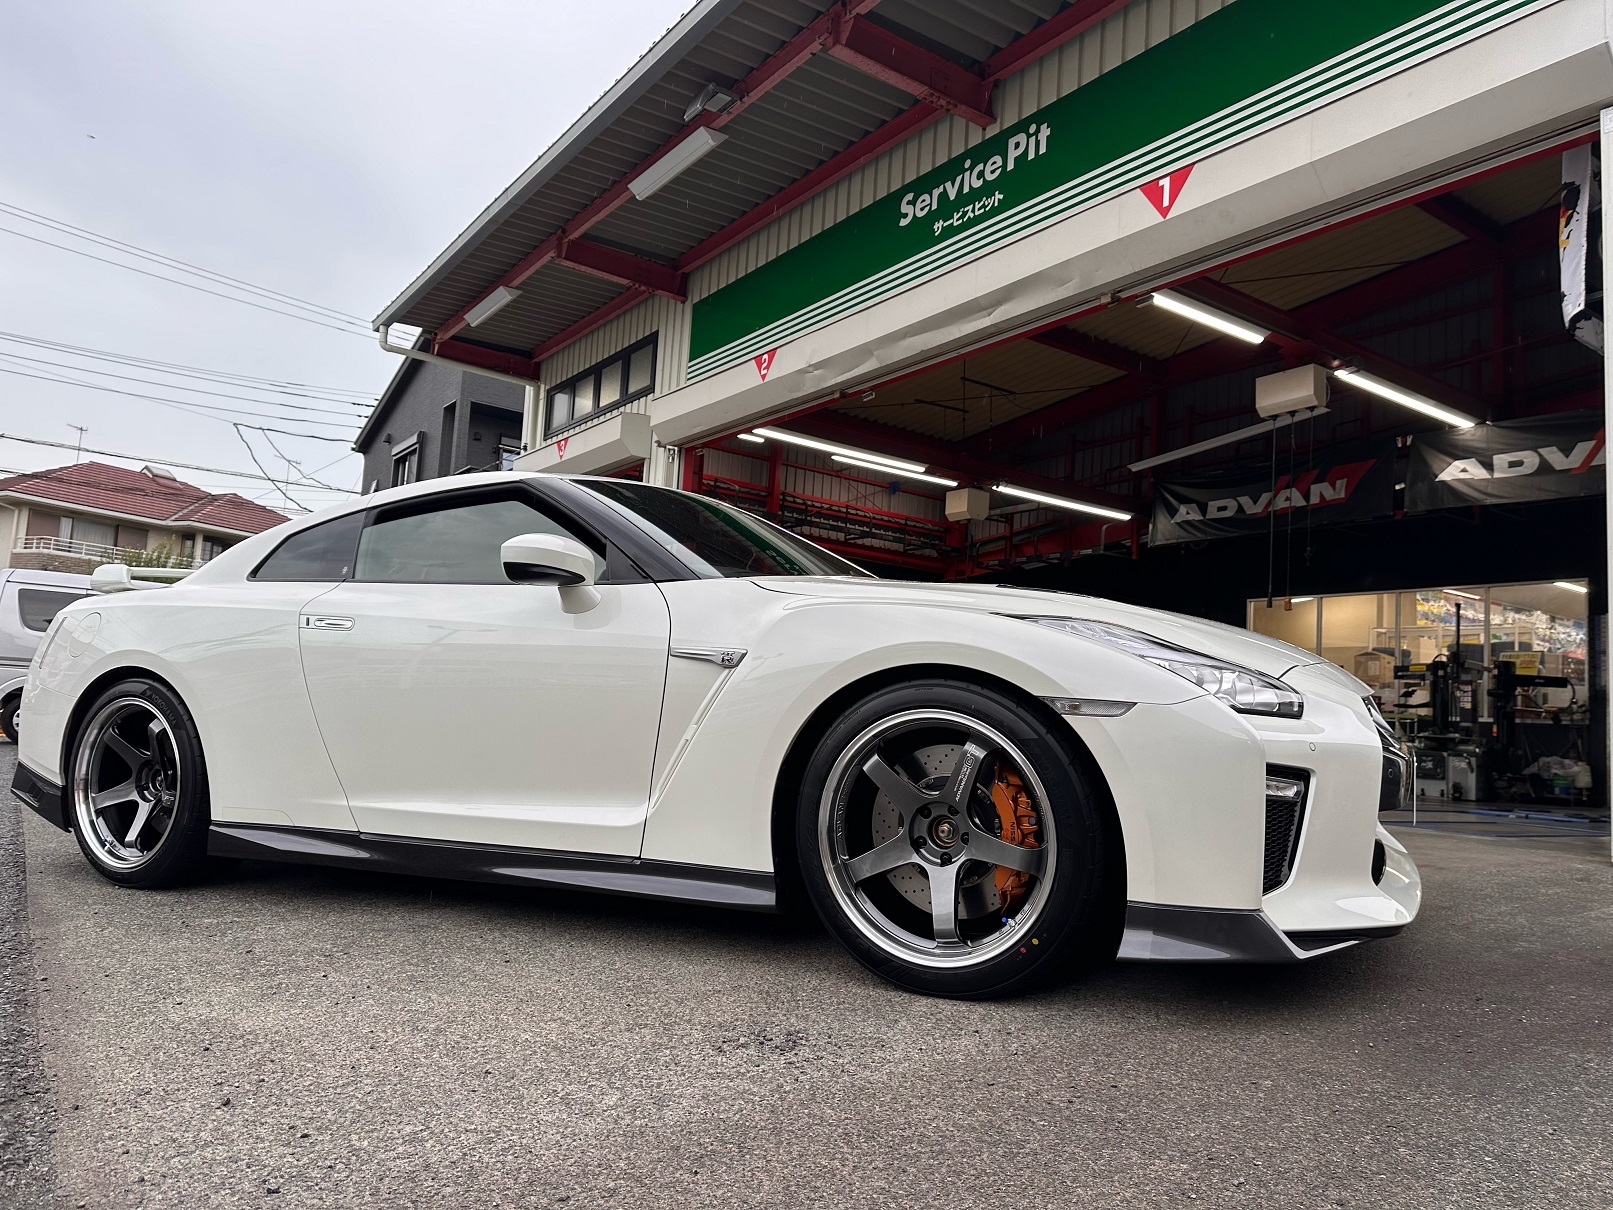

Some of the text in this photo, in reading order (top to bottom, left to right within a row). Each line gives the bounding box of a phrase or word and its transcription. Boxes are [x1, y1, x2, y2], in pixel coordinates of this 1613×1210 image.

[899, 122, 1051, 227] Service Pit
[1158, 176, 1171, 208] 1
[933, 191, 1004, 236] サービスピット
[760, 353, 769, 376] 2
[559, 440, 566, 456] 3
[1435, 440, 1606, 482] ADV
[1171, 477, 1347, 523] ADVAN
[151, 693, 177, 727] YOKOHAMA
